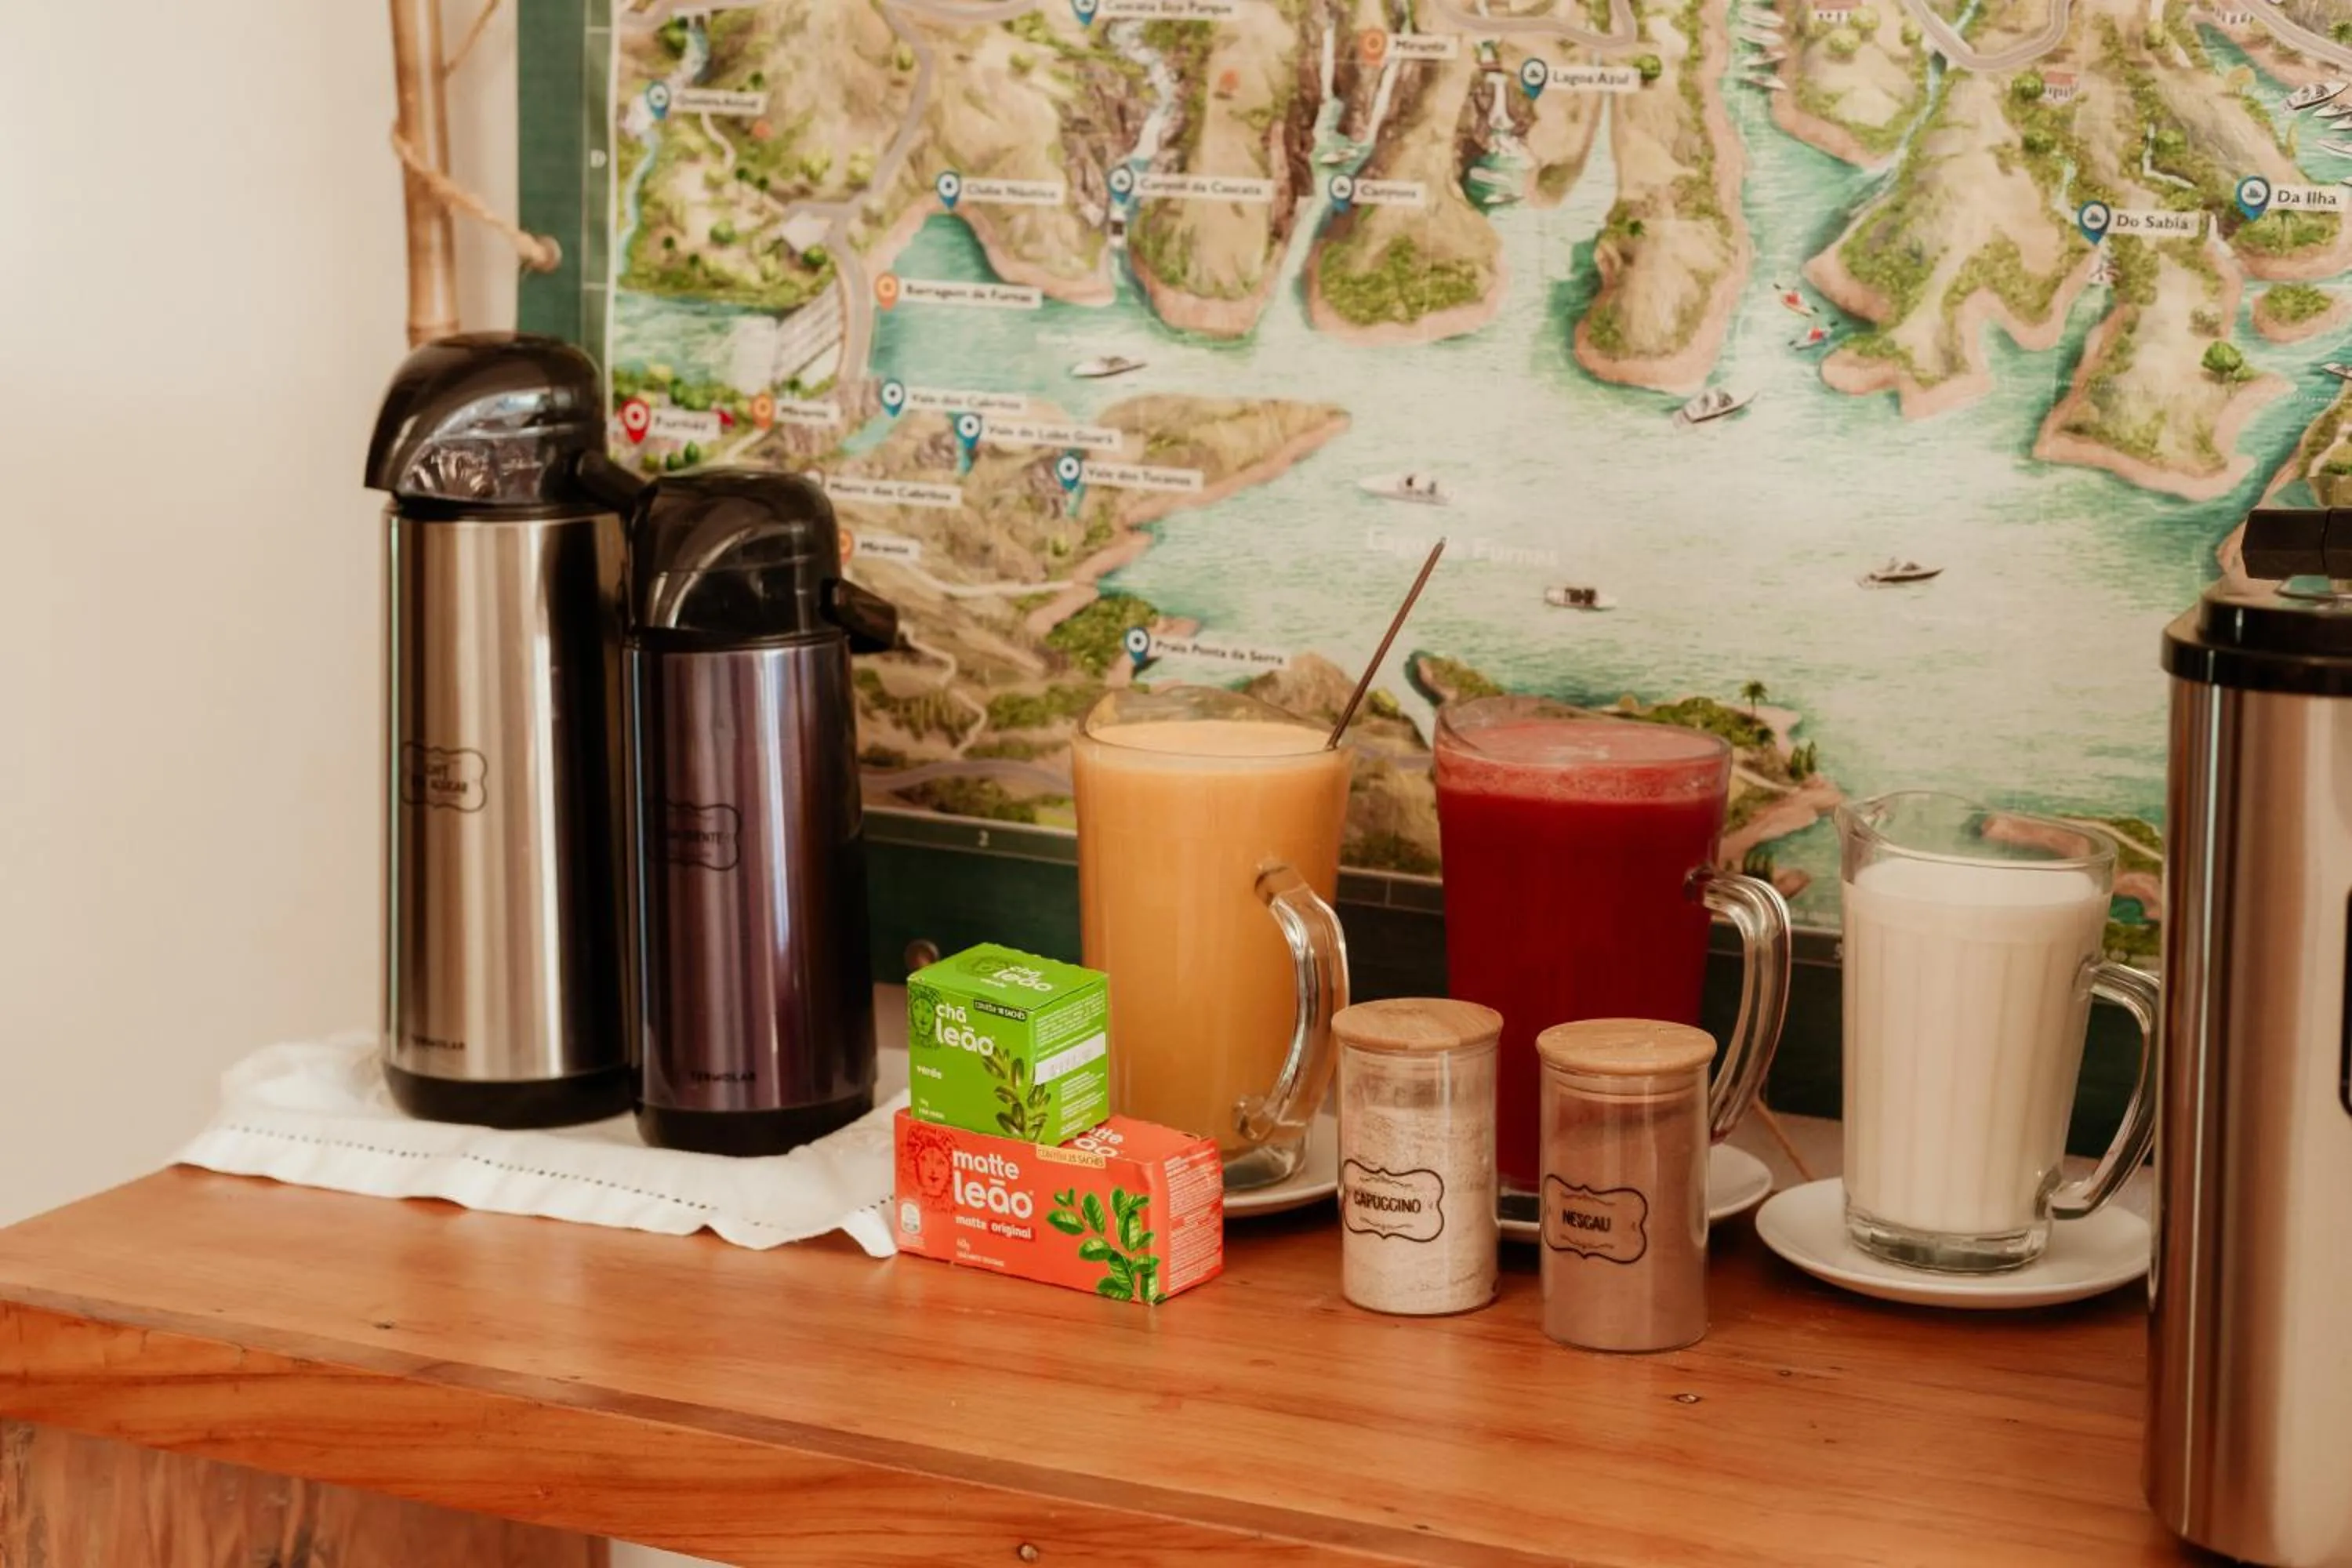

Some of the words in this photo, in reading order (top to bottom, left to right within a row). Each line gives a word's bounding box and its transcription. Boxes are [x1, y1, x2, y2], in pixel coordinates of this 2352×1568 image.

[1552, 70, 1594, 87] Lagoa
[1597, 72, 1629, 85] Azul
[2277, 188, 2300, 204] Da
[2306, 190, 2337, 205] Ilha
[2117, 213, 2140, 228] Do
[935, 1017, 995, 1056] leão
[953, 1149, 1020, 1181] matte
[953, 1168, 1034, 1220] leão
[1353, 1188, 1422, 1215] CAPUCCINO
[955, 1215, 988, 1231] matte
[991, 1221, 1033, 1240] original
[1562, 1207, 1612, 1234] NESCAU
